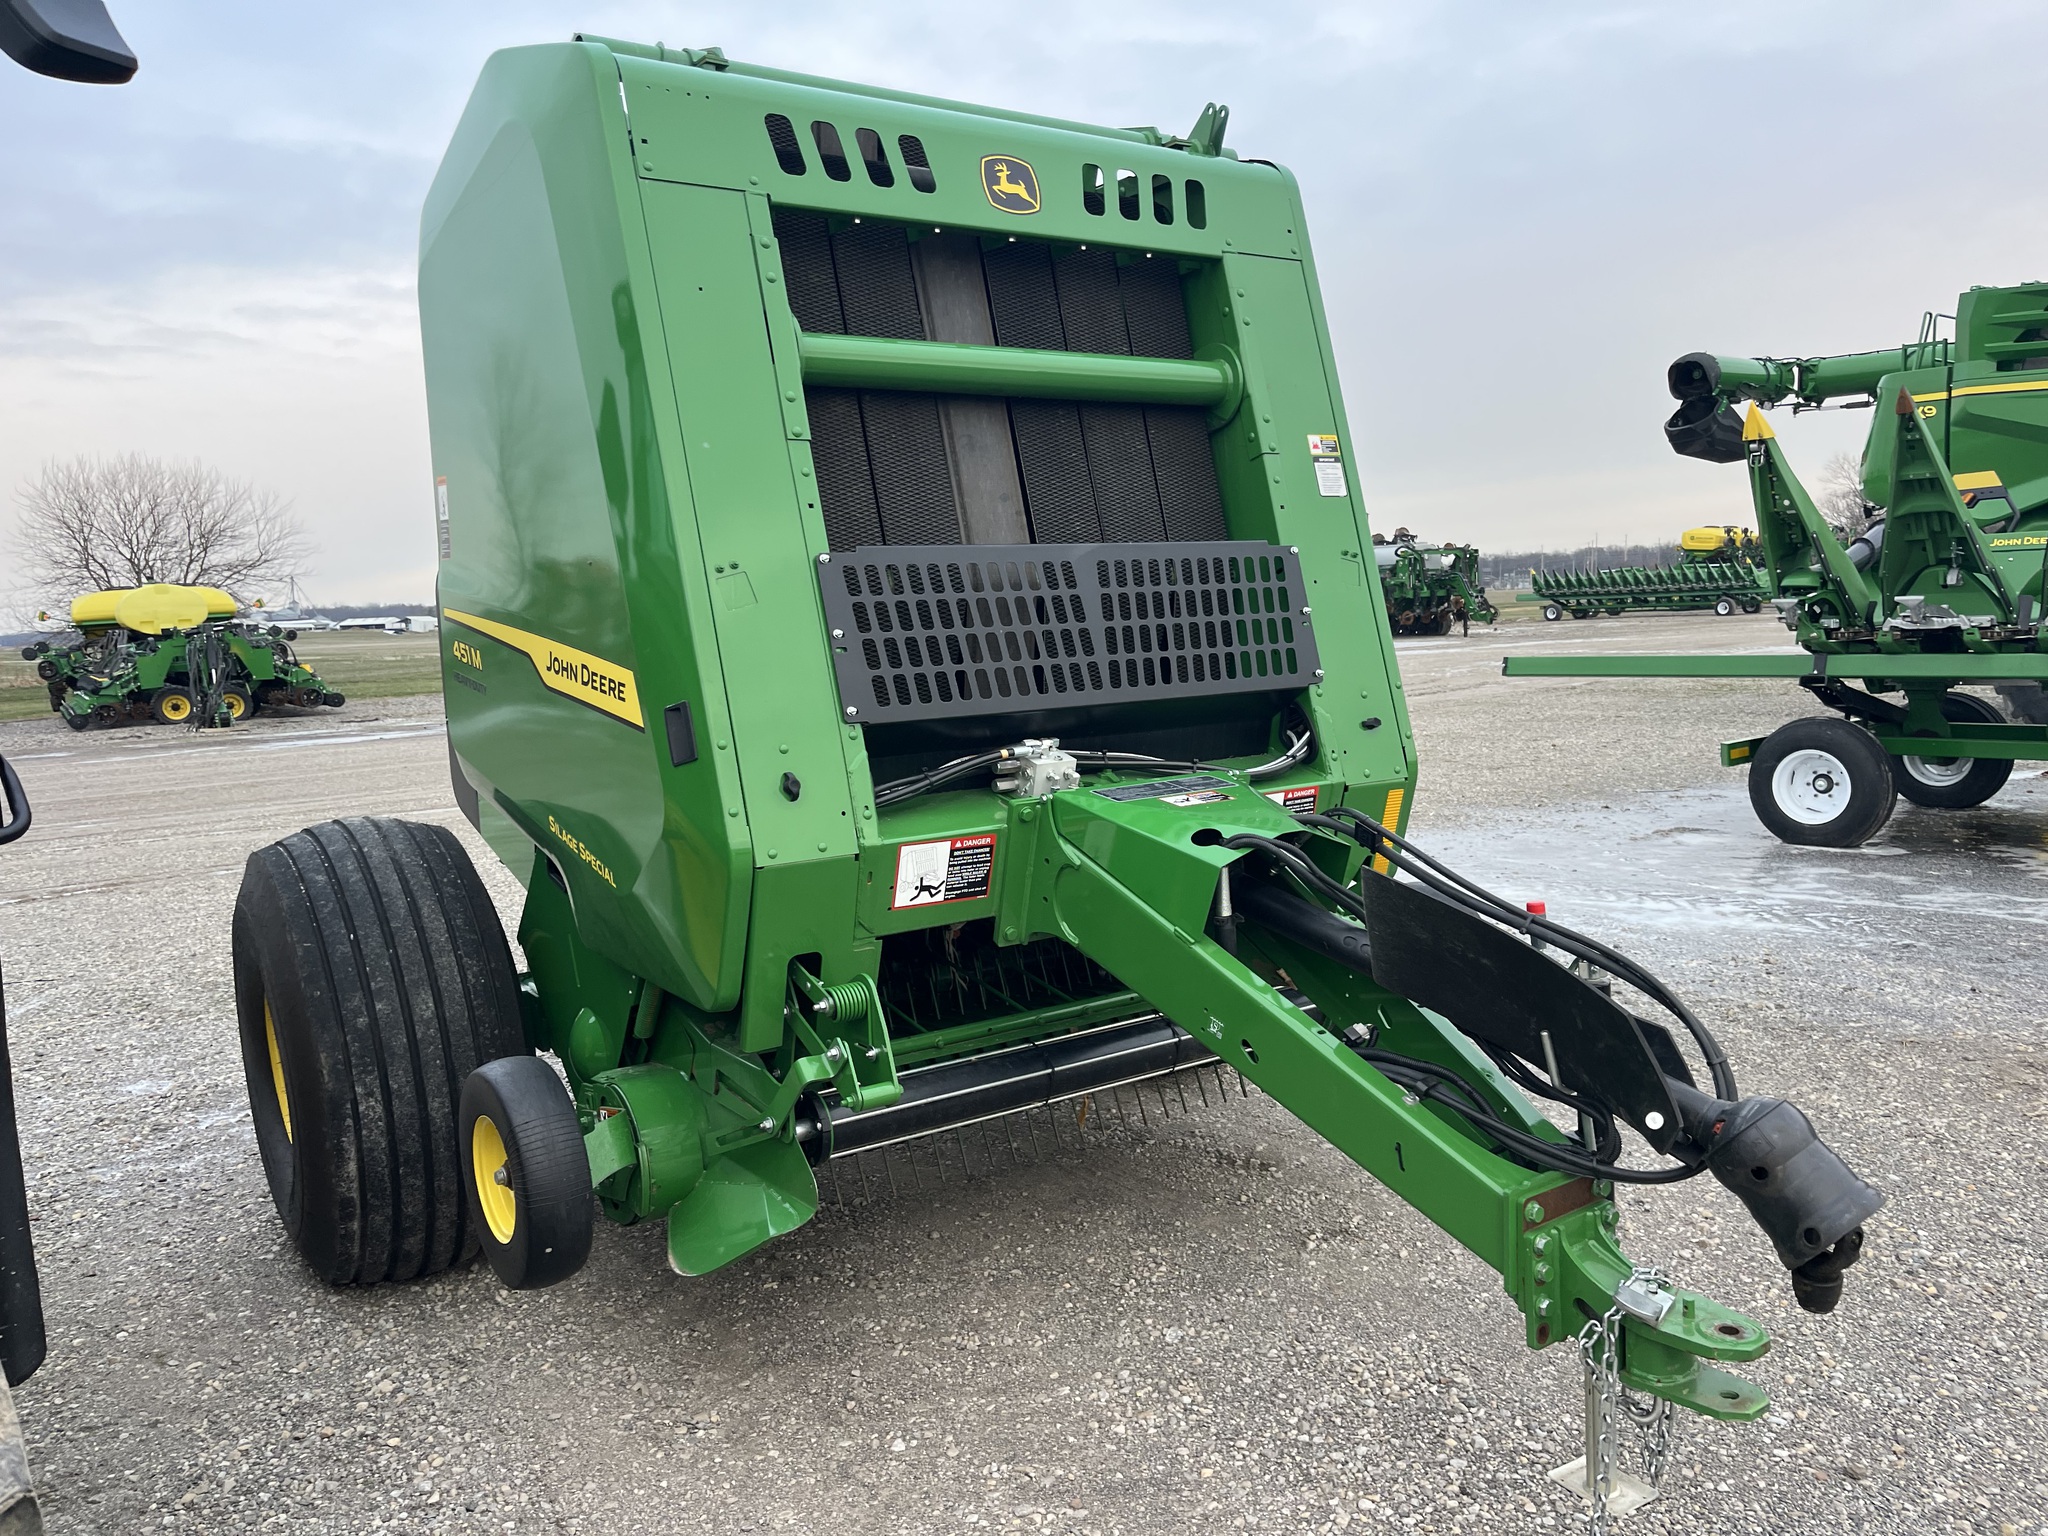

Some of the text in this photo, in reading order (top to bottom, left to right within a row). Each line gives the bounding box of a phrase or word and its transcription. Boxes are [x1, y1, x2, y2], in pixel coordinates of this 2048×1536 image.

[1990, 538, 2022, 547] JOHN
[453, 640, 483, 671] 451M
[546, 651, 626, 702] JOHN DEERE
[1293, 789, 1315, 797] DANGER
[548, 815, 617, 889] SILAGE SPECIAL
[963, 838, 991, 846] DANGER
